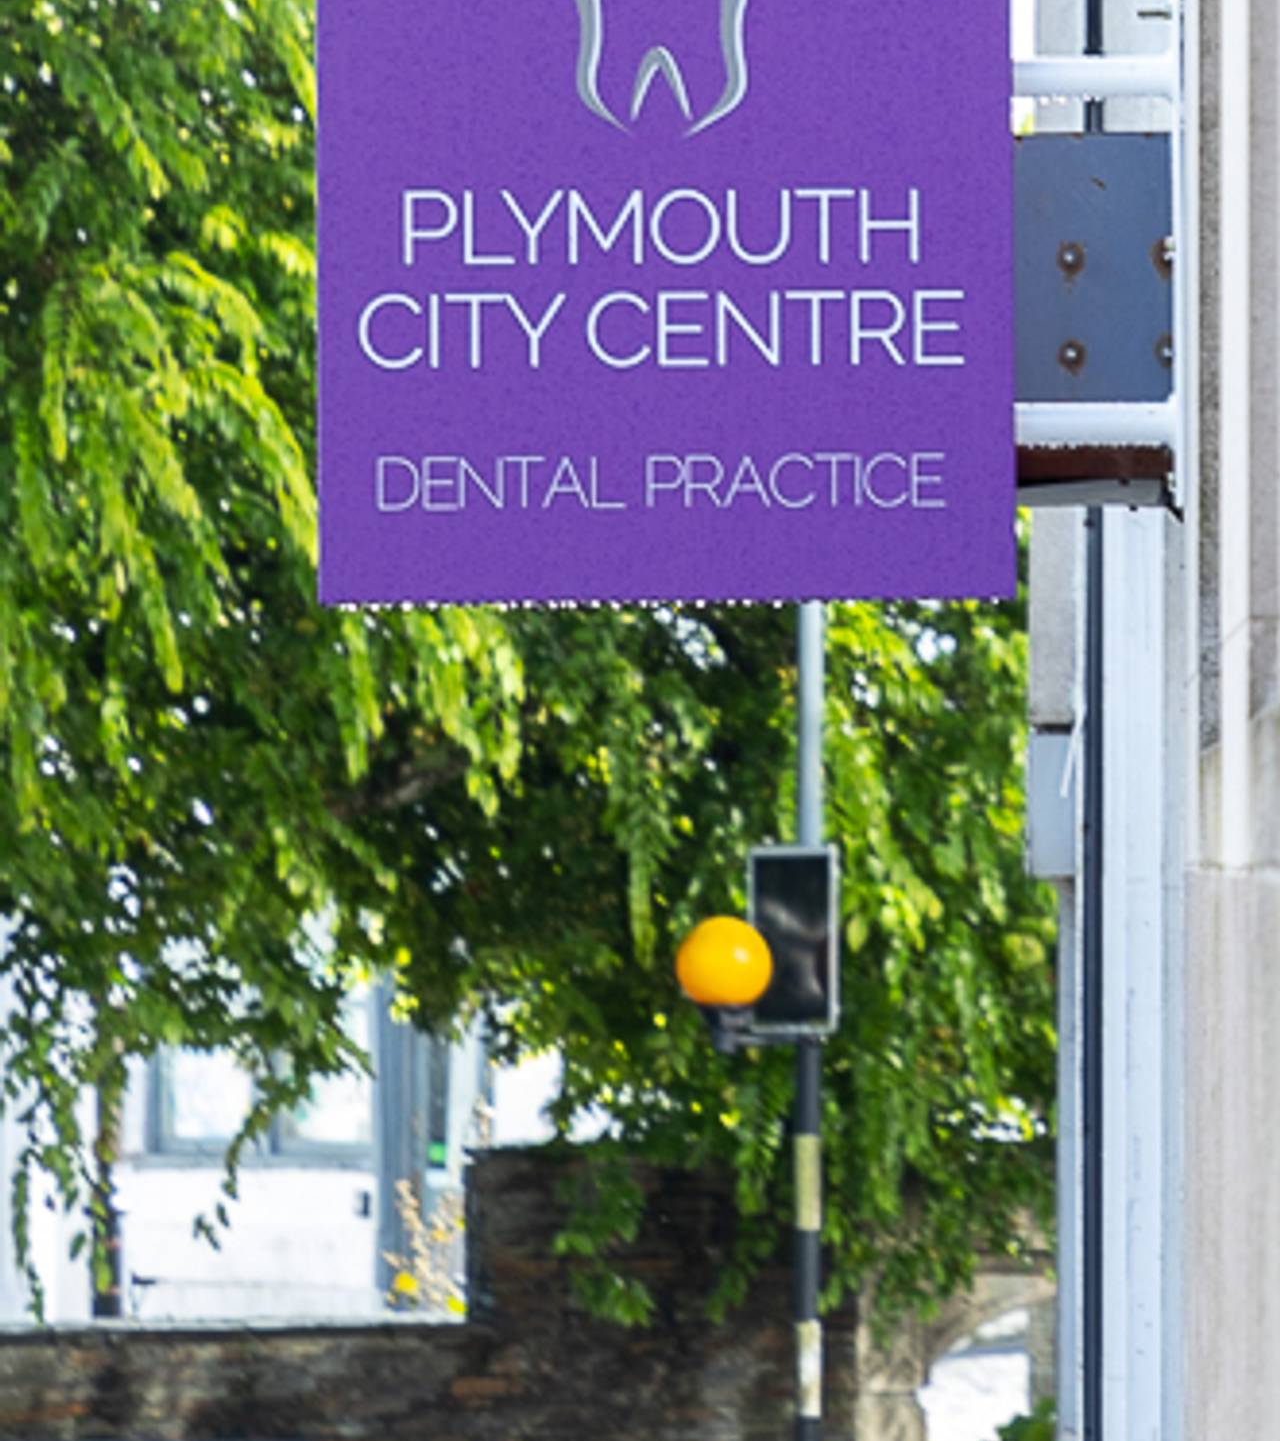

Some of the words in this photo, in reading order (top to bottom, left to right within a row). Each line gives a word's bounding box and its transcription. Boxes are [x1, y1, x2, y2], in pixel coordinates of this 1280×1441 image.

[403, 188, 919, 265] PLYMOUTH
[358, 292, 565, 369] CITY
[586, 289, 965, 369] CENTRE
[376, 455, 625, 511] DENTAL
[645, 452, 945, 508] PRACTICE
